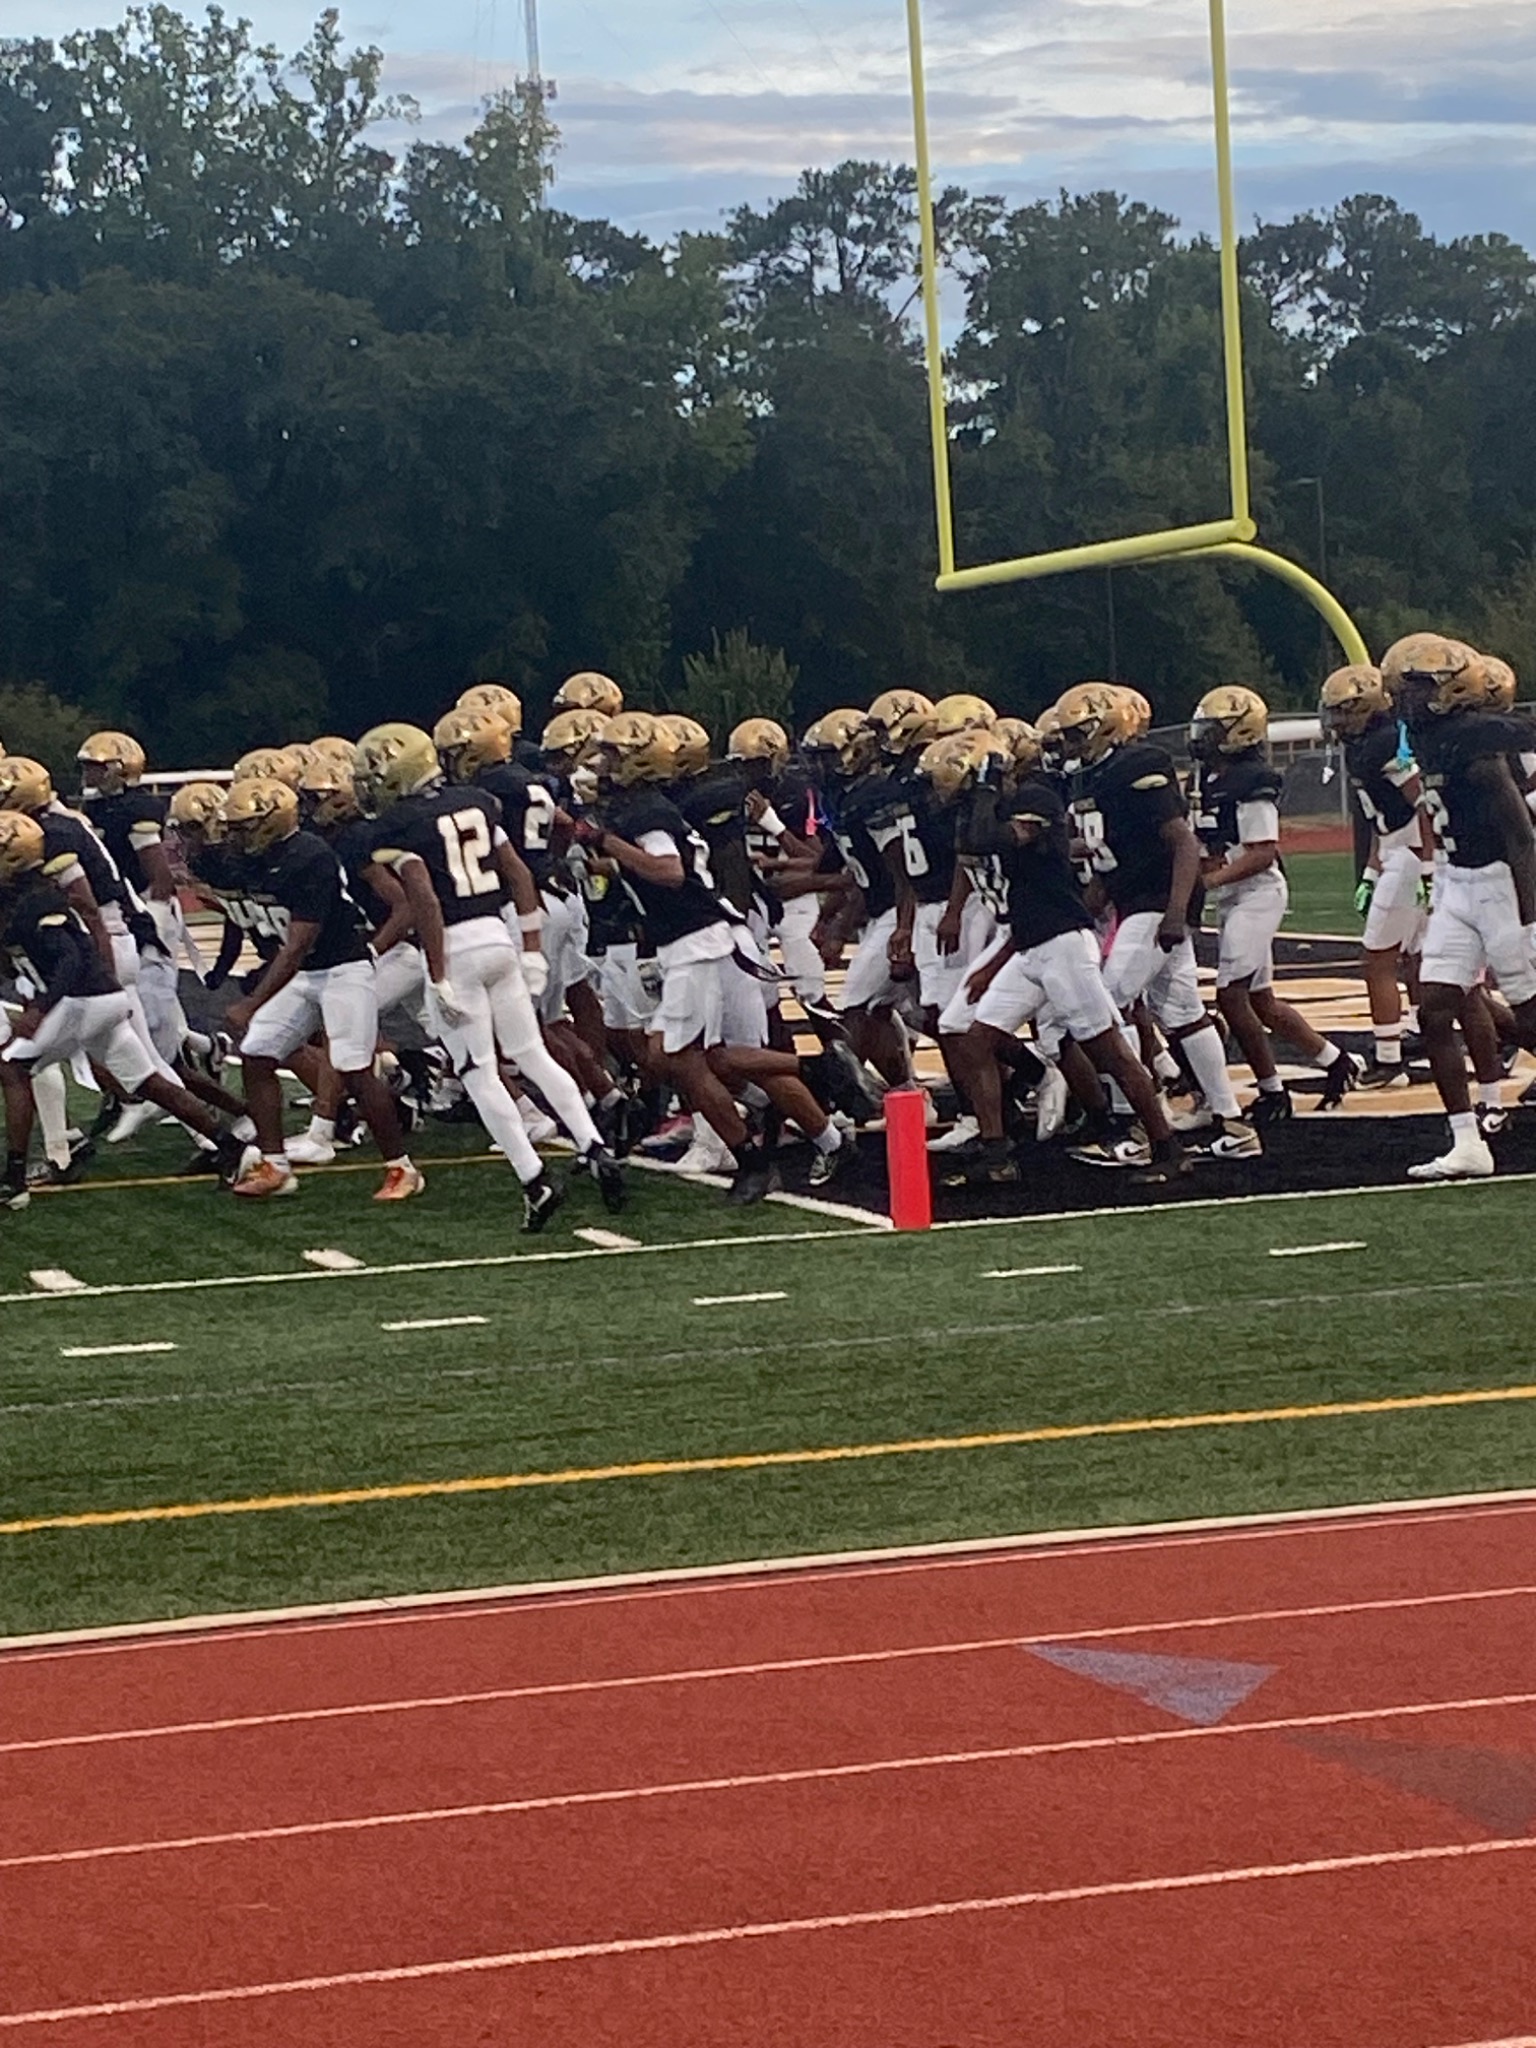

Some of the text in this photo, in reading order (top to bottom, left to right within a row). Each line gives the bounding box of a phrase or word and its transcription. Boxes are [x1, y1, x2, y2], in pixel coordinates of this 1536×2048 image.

[524, 784, 555, 850] 2
[897, 814, 930, 877] 6
[437, 807, 500, 898] 12
